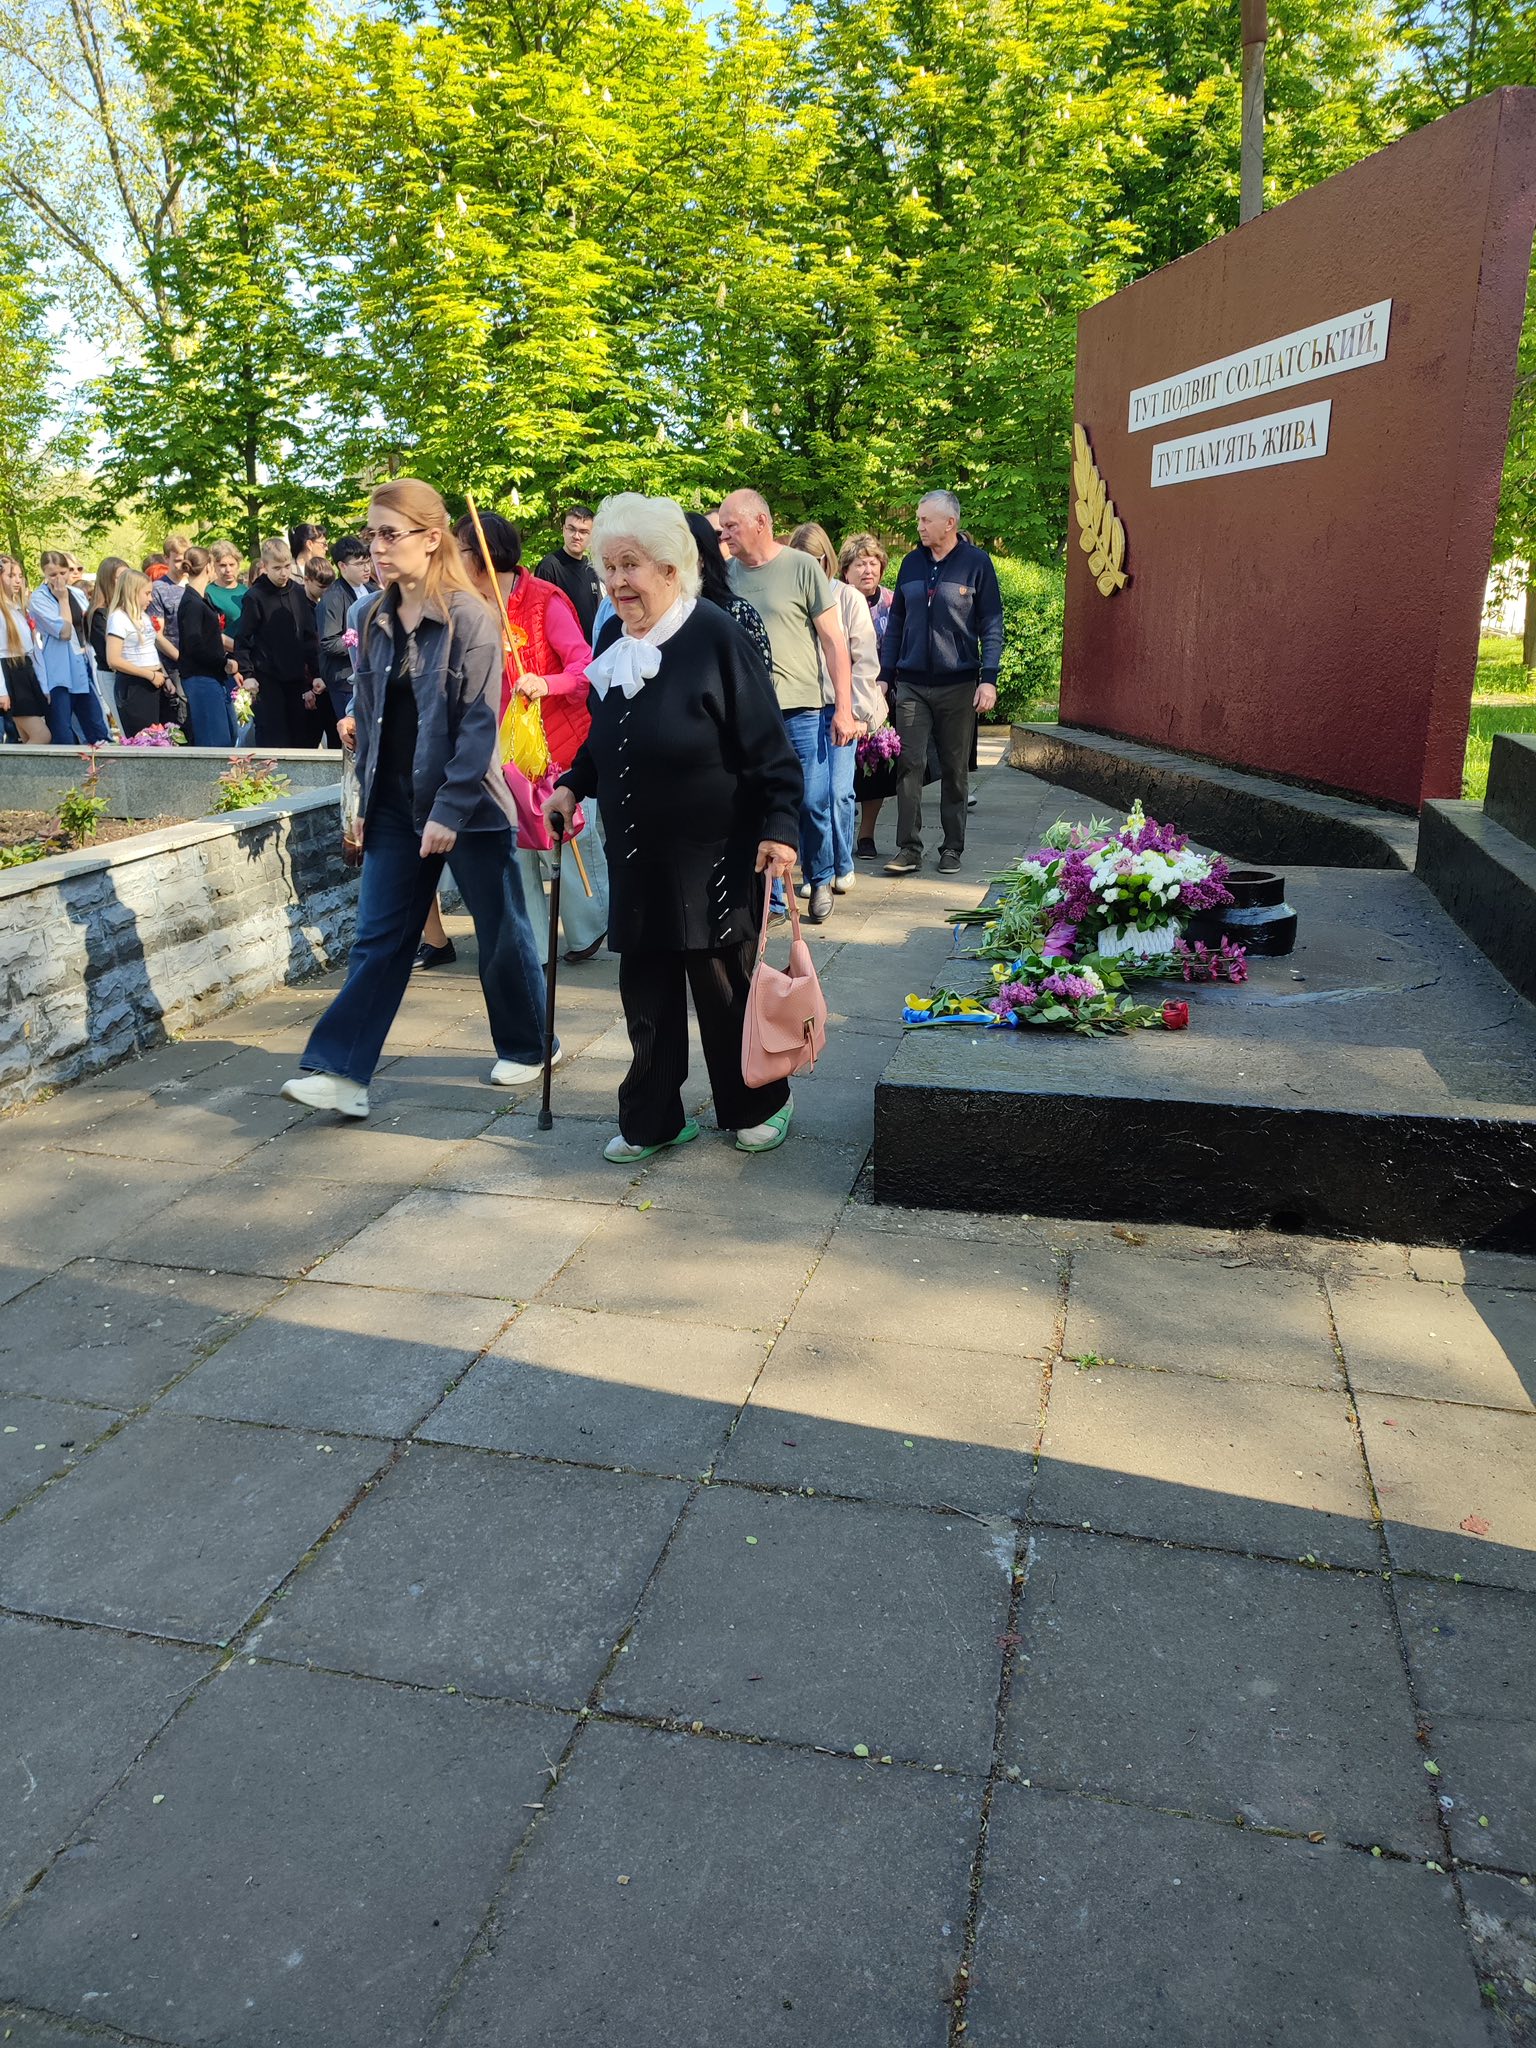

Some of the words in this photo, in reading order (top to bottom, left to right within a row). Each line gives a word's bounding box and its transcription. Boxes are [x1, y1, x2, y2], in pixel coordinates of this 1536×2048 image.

[1134, 393, 1159, 422] ТУТ
[1162, 371, 1222, 414] ПОДВИГ
[1226, 310, 1378, 395] СОЛДАТСЬКИЙ,
[1158, 449, 1183, 478] ТУТ
[1185, 432, 1257, 472] ПАМ'ЯТЬ
[1261, 417, 1317, 457] ЖИВА
